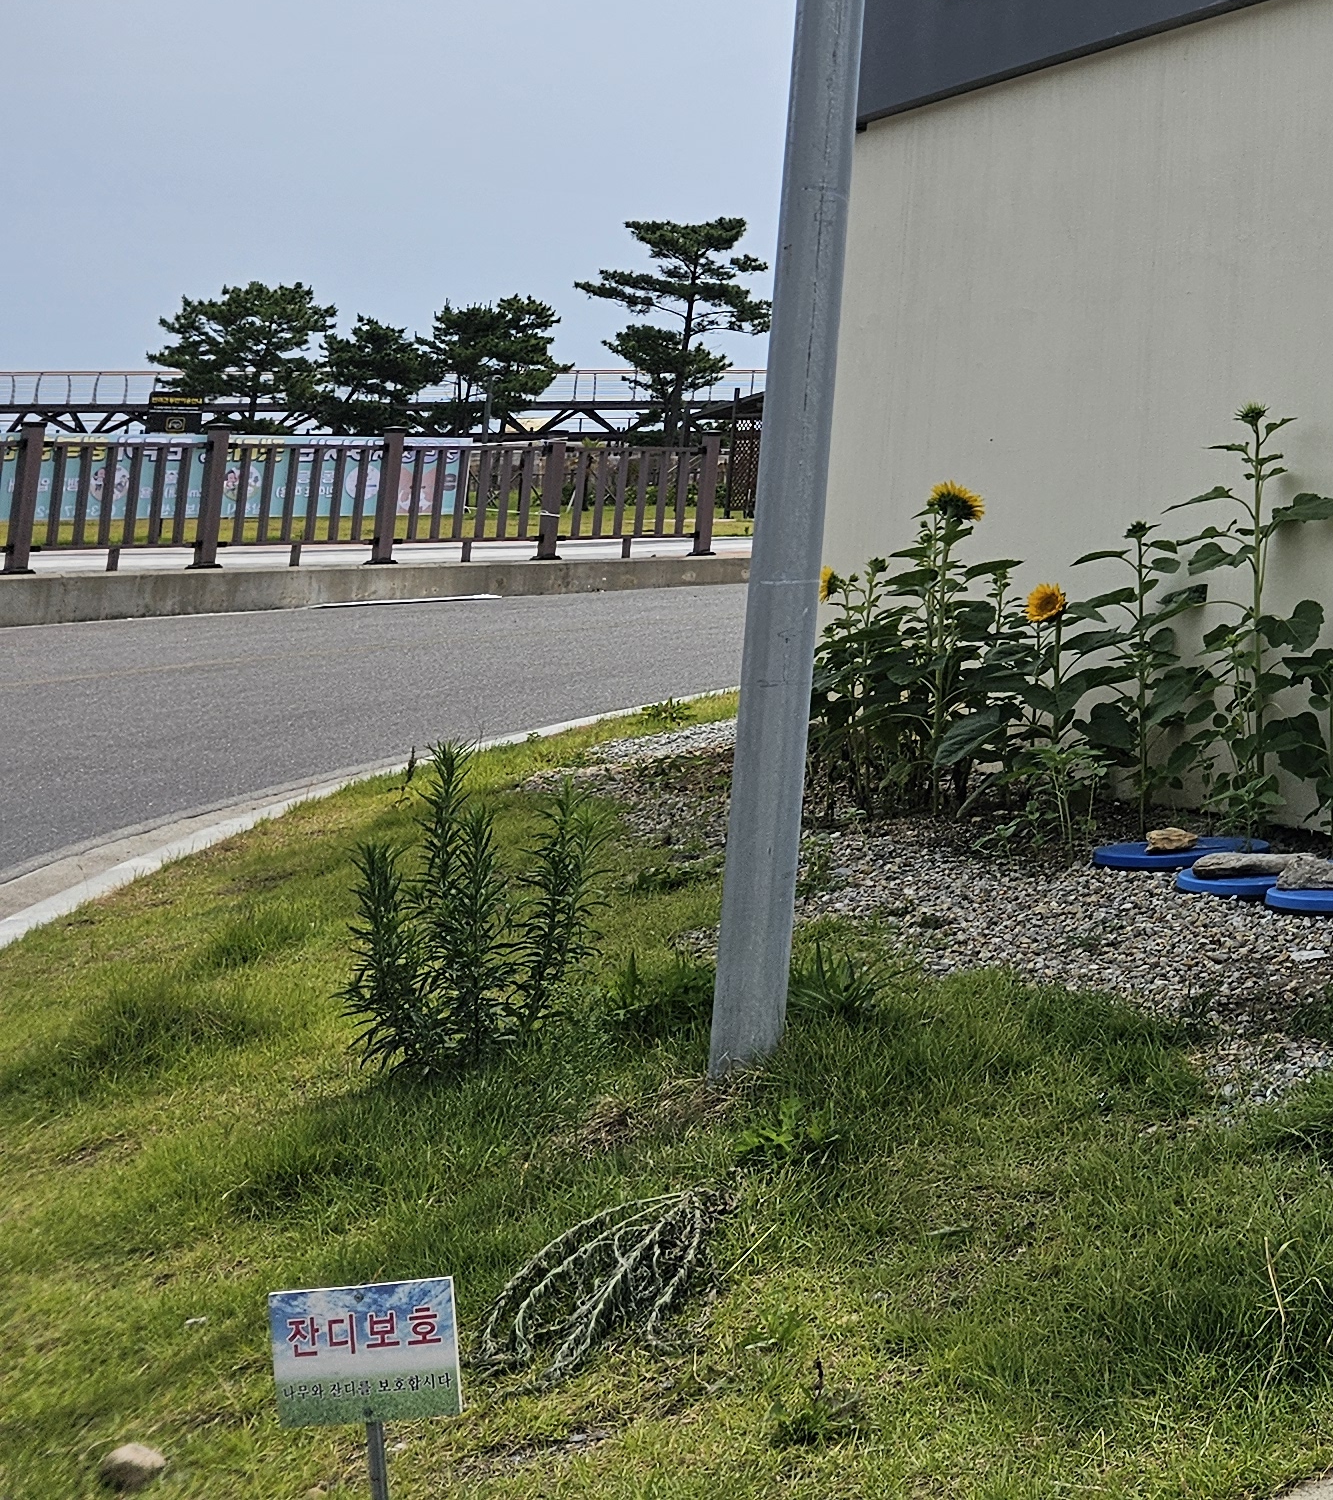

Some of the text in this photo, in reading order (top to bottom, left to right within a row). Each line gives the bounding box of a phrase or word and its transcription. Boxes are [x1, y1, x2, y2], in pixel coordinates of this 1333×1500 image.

[286, 1305, 442, 1358] 잔디보호
[282, 1372, 452, 1399] 나무와 잔디를 보호합시다
